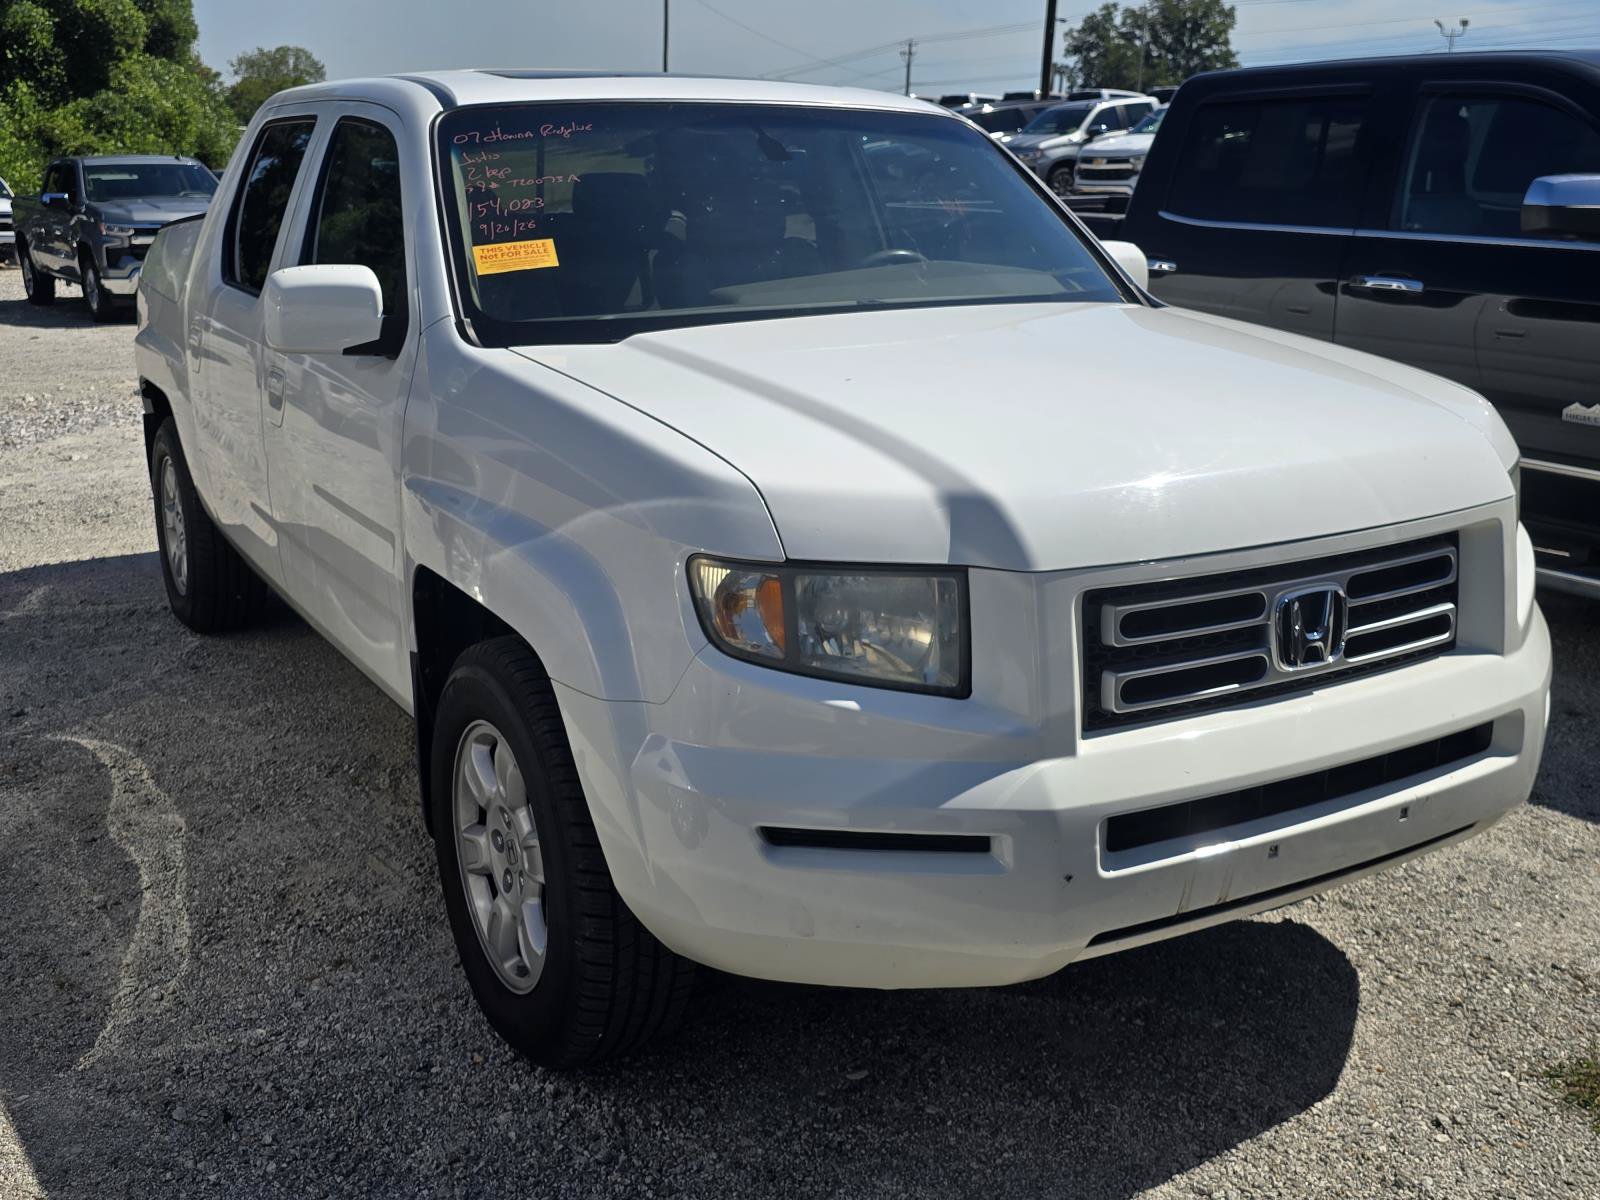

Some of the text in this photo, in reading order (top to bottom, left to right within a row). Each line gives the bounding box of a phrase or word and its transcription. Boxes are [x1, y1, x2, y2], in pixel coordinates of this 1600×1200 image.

[480, 242, 548, 255] THIS VEHICLE
[500, 250, 521, 258] FOR
[523, 247, 550, 256] SALE
